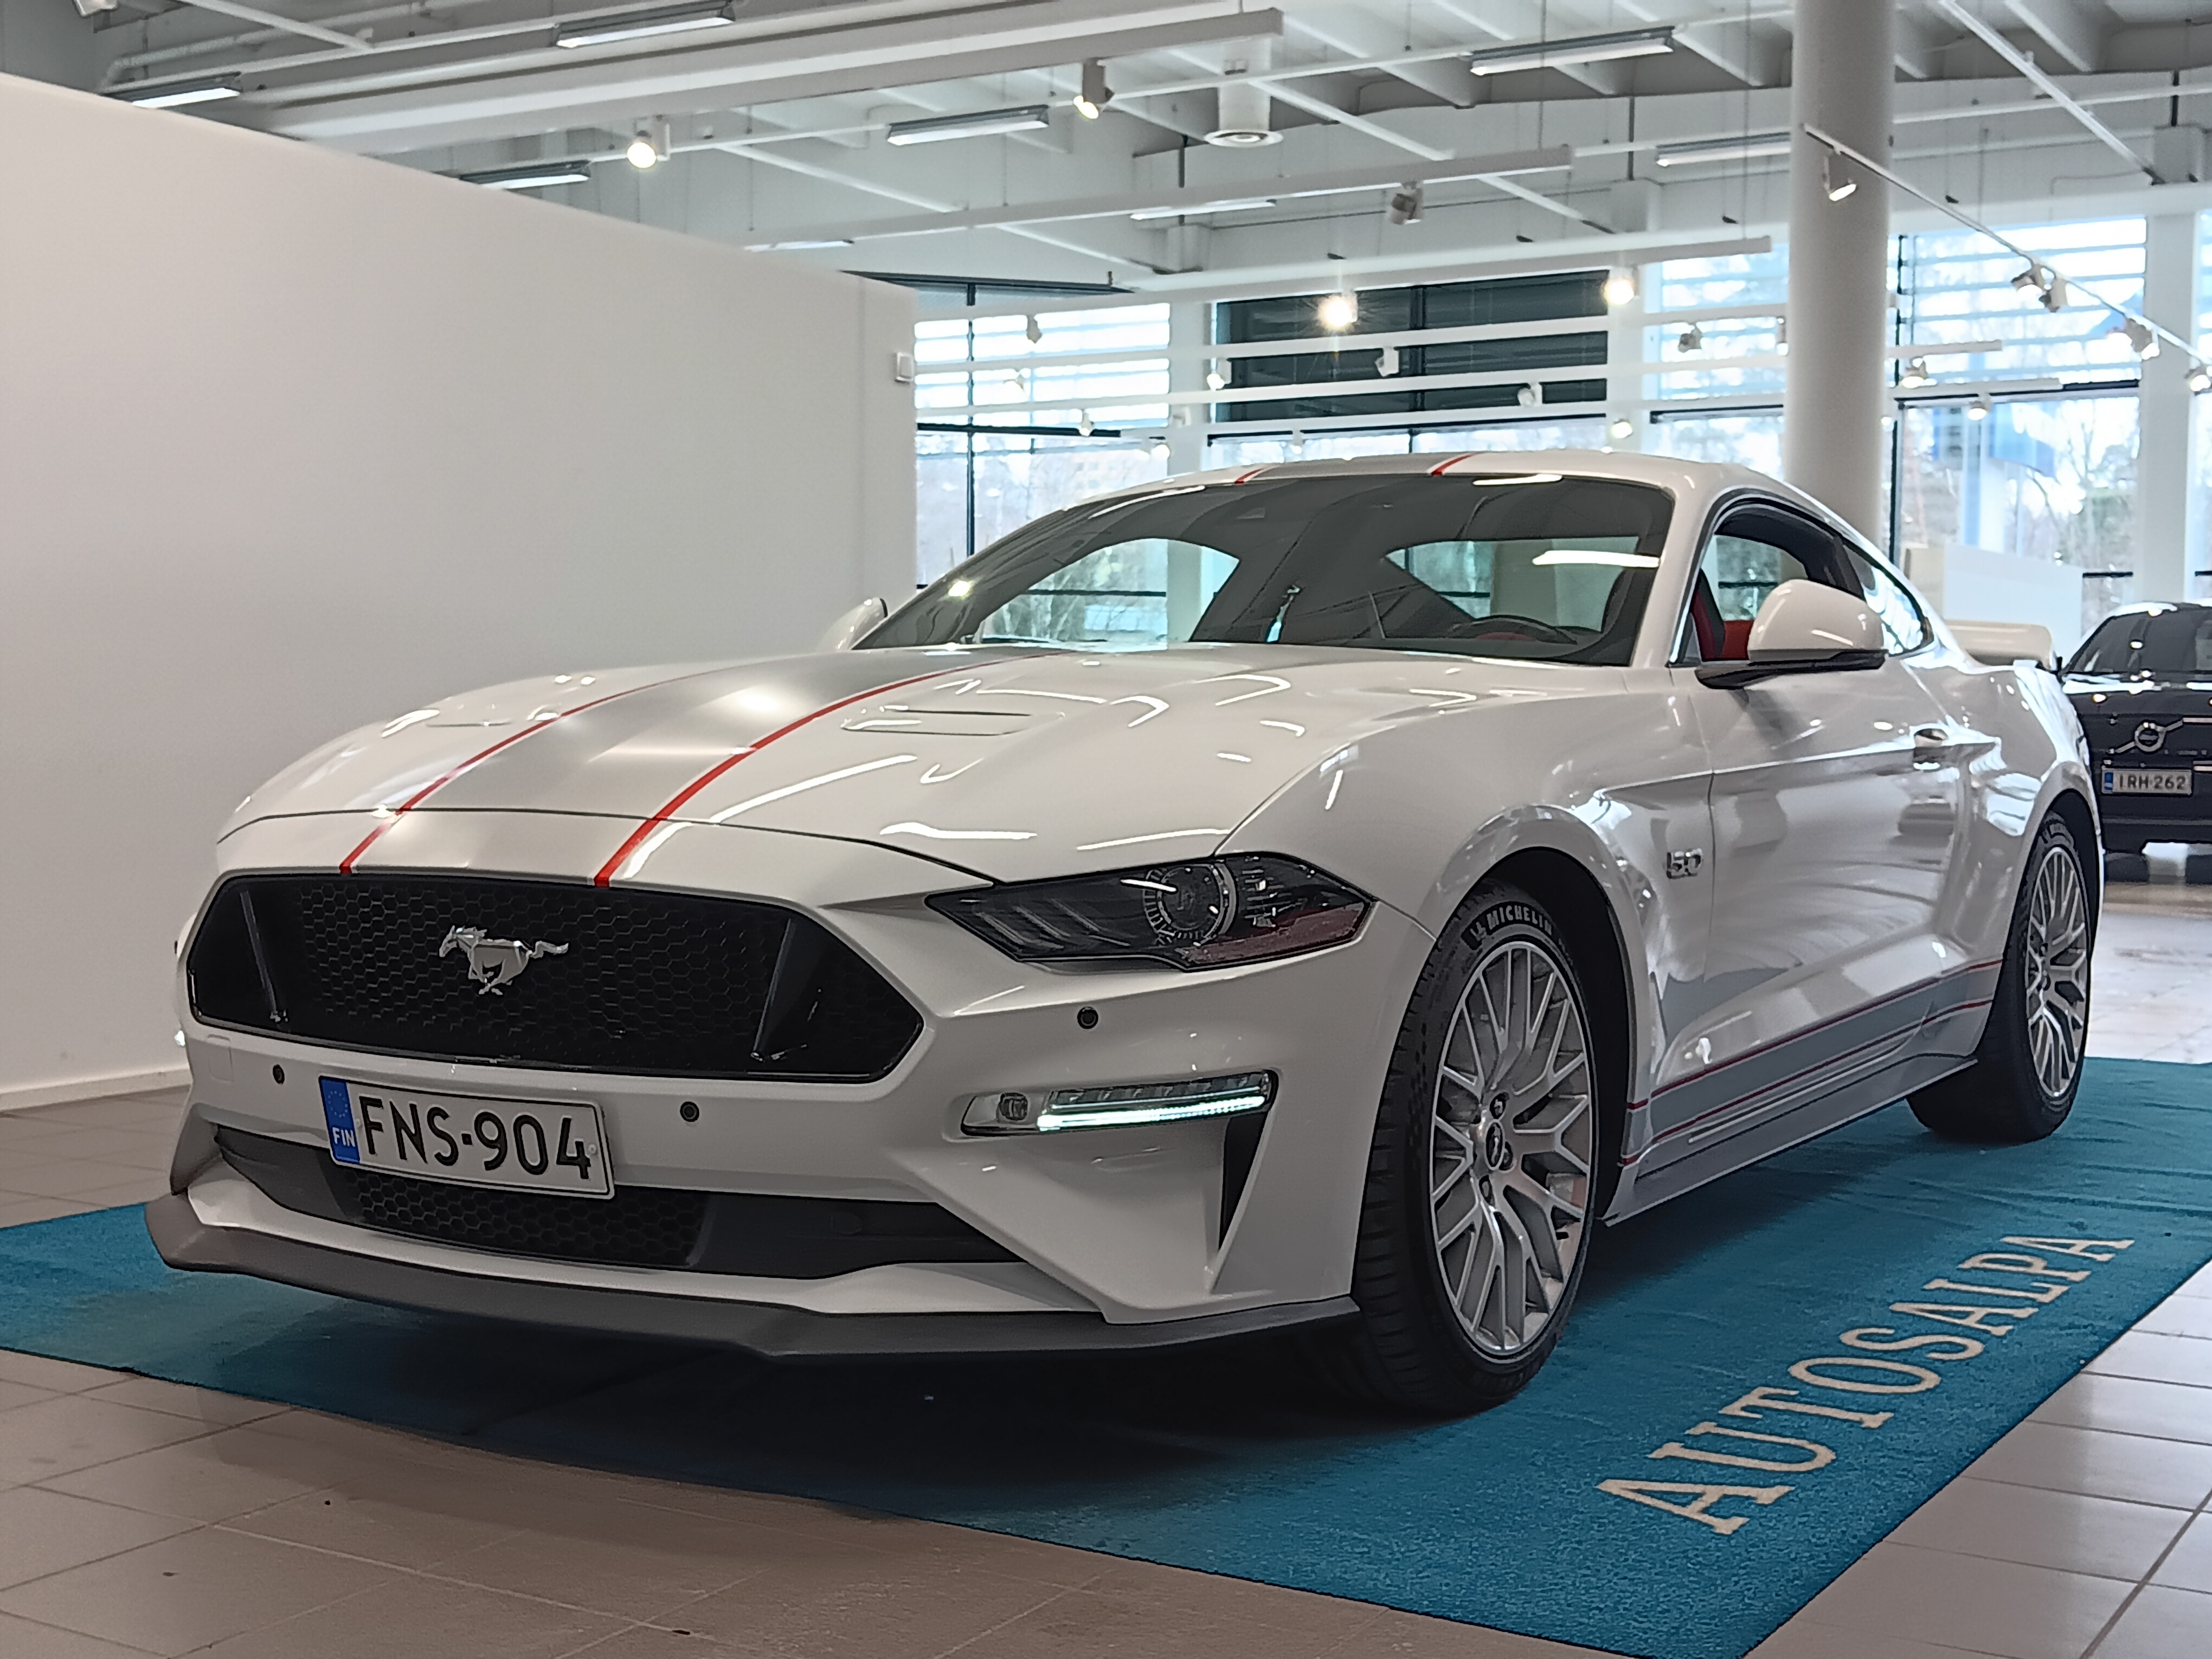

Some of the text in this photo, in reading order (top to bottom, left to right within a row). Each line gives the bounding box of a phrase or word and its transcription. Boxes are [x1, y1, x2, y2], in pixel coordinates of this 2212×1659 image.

[1487, 905, 1552, 935] MICHELIN
[332, 1127, 356, 1147] FIN
[359, 1096, 591, 1180] FNS-904
[1597, 1236, 2134, 1534] AUTOSALPA
